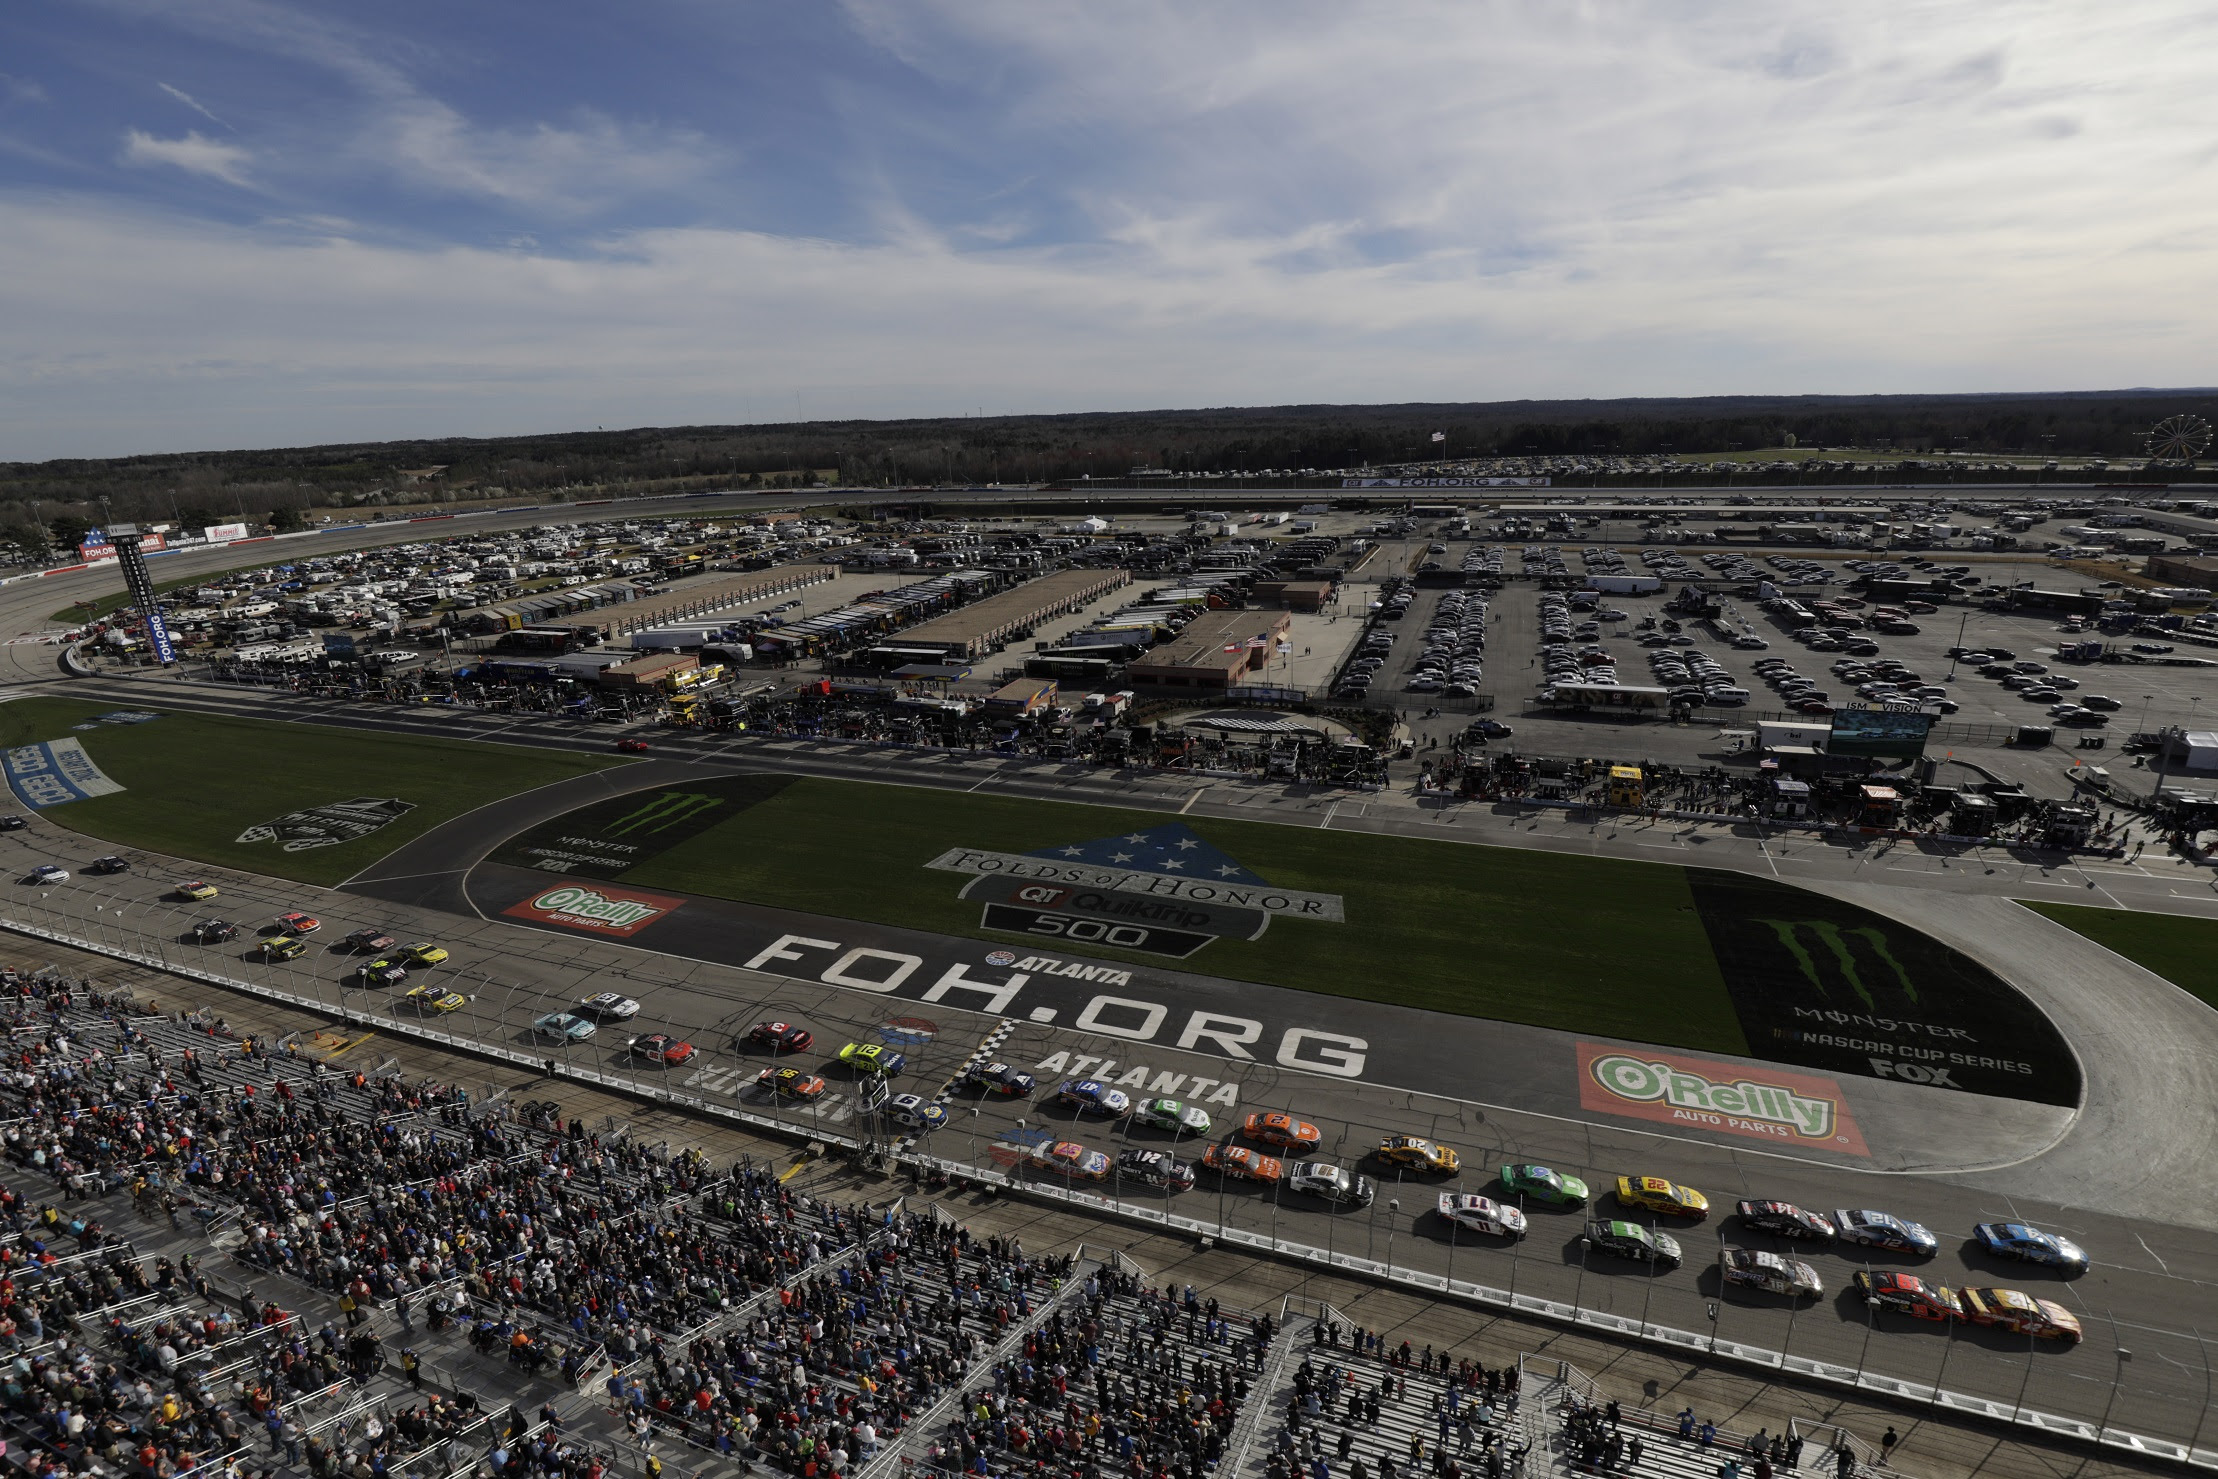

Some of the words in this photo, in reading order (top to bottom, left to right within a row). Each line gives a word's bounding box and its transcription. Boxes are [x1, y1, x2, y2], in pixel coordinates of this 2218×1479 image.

[1399, 478, 1489, 487] FOH.ORG
[212, 526, 240, 538] SUMMIT
[138, 535, 160, 547] nnai
[151, 615, 173, 662] FOH.ORG
[1846, 702, 1867, 710] ISM
[1882, 703, 1922, 713] VISION
[7, 745, 48, 774] GEICO
[19, 774, 76, 805] GEICO
[532, 858, 579, 873] FOX
[953, 851, 1084, 882] FOLDS
[1095, 873, 1139, 891] of
[1145, 877, 1325, 914] HONOR
[536, 888, 655, 926] O'Reilly
[1018, 885, 1066, 903] QT
[1071, 891, 1211, 930] QuikTrip
[547, 913, 573, 922] AUTO
[574, 918, 603, 928] PARTS
[1028, 914, 1149, 947] 500
[1010, 955, 1133, 987] ATLANTA
[743, 935, 1368, 1078] FOH.ORG
[771, 1022, 785, 1033] 3
[1794, 1006, 1979, 1042] MONSTER
[861, 1045, 878, 1055] 21
[1803, 1032, 1894, 1055] NASCAR
[1898, 1045, 1946, 1061] CUP
[1950, 1052, 2034, 1075] SERIES
[863, 1062, 873, 1070] 21
[886, 1053, 902, 1068] MOEN
[778, 1068, 799, 1079] 95
[1034, 1051, 1240, 1108] ATLANTA
[1868, 1057, 1963, 1089] FOX
[1080, 1082, 1099, 1092] 47
[1597, 1054, 1831, 1137] O'Reilly
[1162, 1099, 1178, 1112] 8
[1166, 1120, 1176, 1129] 8
[1270, 1115, 1285, 1125] 2
[1673, 1109, 1721, 1126] AUTO
[1727, 1117, 1789, 1137] PARTS
[1408, 1138, 1426, 1150] 20
[1141, 1151, 1163, 1164] 24
[1229, 1147, 1246, 1159] 41
[1120, 1165, 1143, 1175] LIBERTY
[1413, 1160, 1428, 1170] 20
[1232, 1170, 1245, 1179] 41
[1647, 1178, 1665, 1191] 22
[1469, 1196, 1489, 1210] 11
[1658, 1202, 1677, 1212] 22
[1775, 1202, 1794, 1215] 14
[1510, 1208, 1519, 1227] FedEx
[1871, 1213, 1891, 1225] 12
[1477, 1221, 1491, 1231] 11
[1624, 1223, 1636, 1236] 1
[1785, 1228, 1801, 1237] 14
[2023, 1227, 2040, 1239] 4
[1881, 1238, 1903, 1248] 12
[1633, 1248, 1641, 1259] 1
[1756, 1251, 1780, 1269] 18
[1727, 1271, 1765, 1283] SNICKERS
[1898, 1273, 1921, 1292] 19
[1771, 1280, 1785, 1292] 18
[1911, 1303, 1929, 1316] 19
[2021, 1322, 2044, 1333] 42
